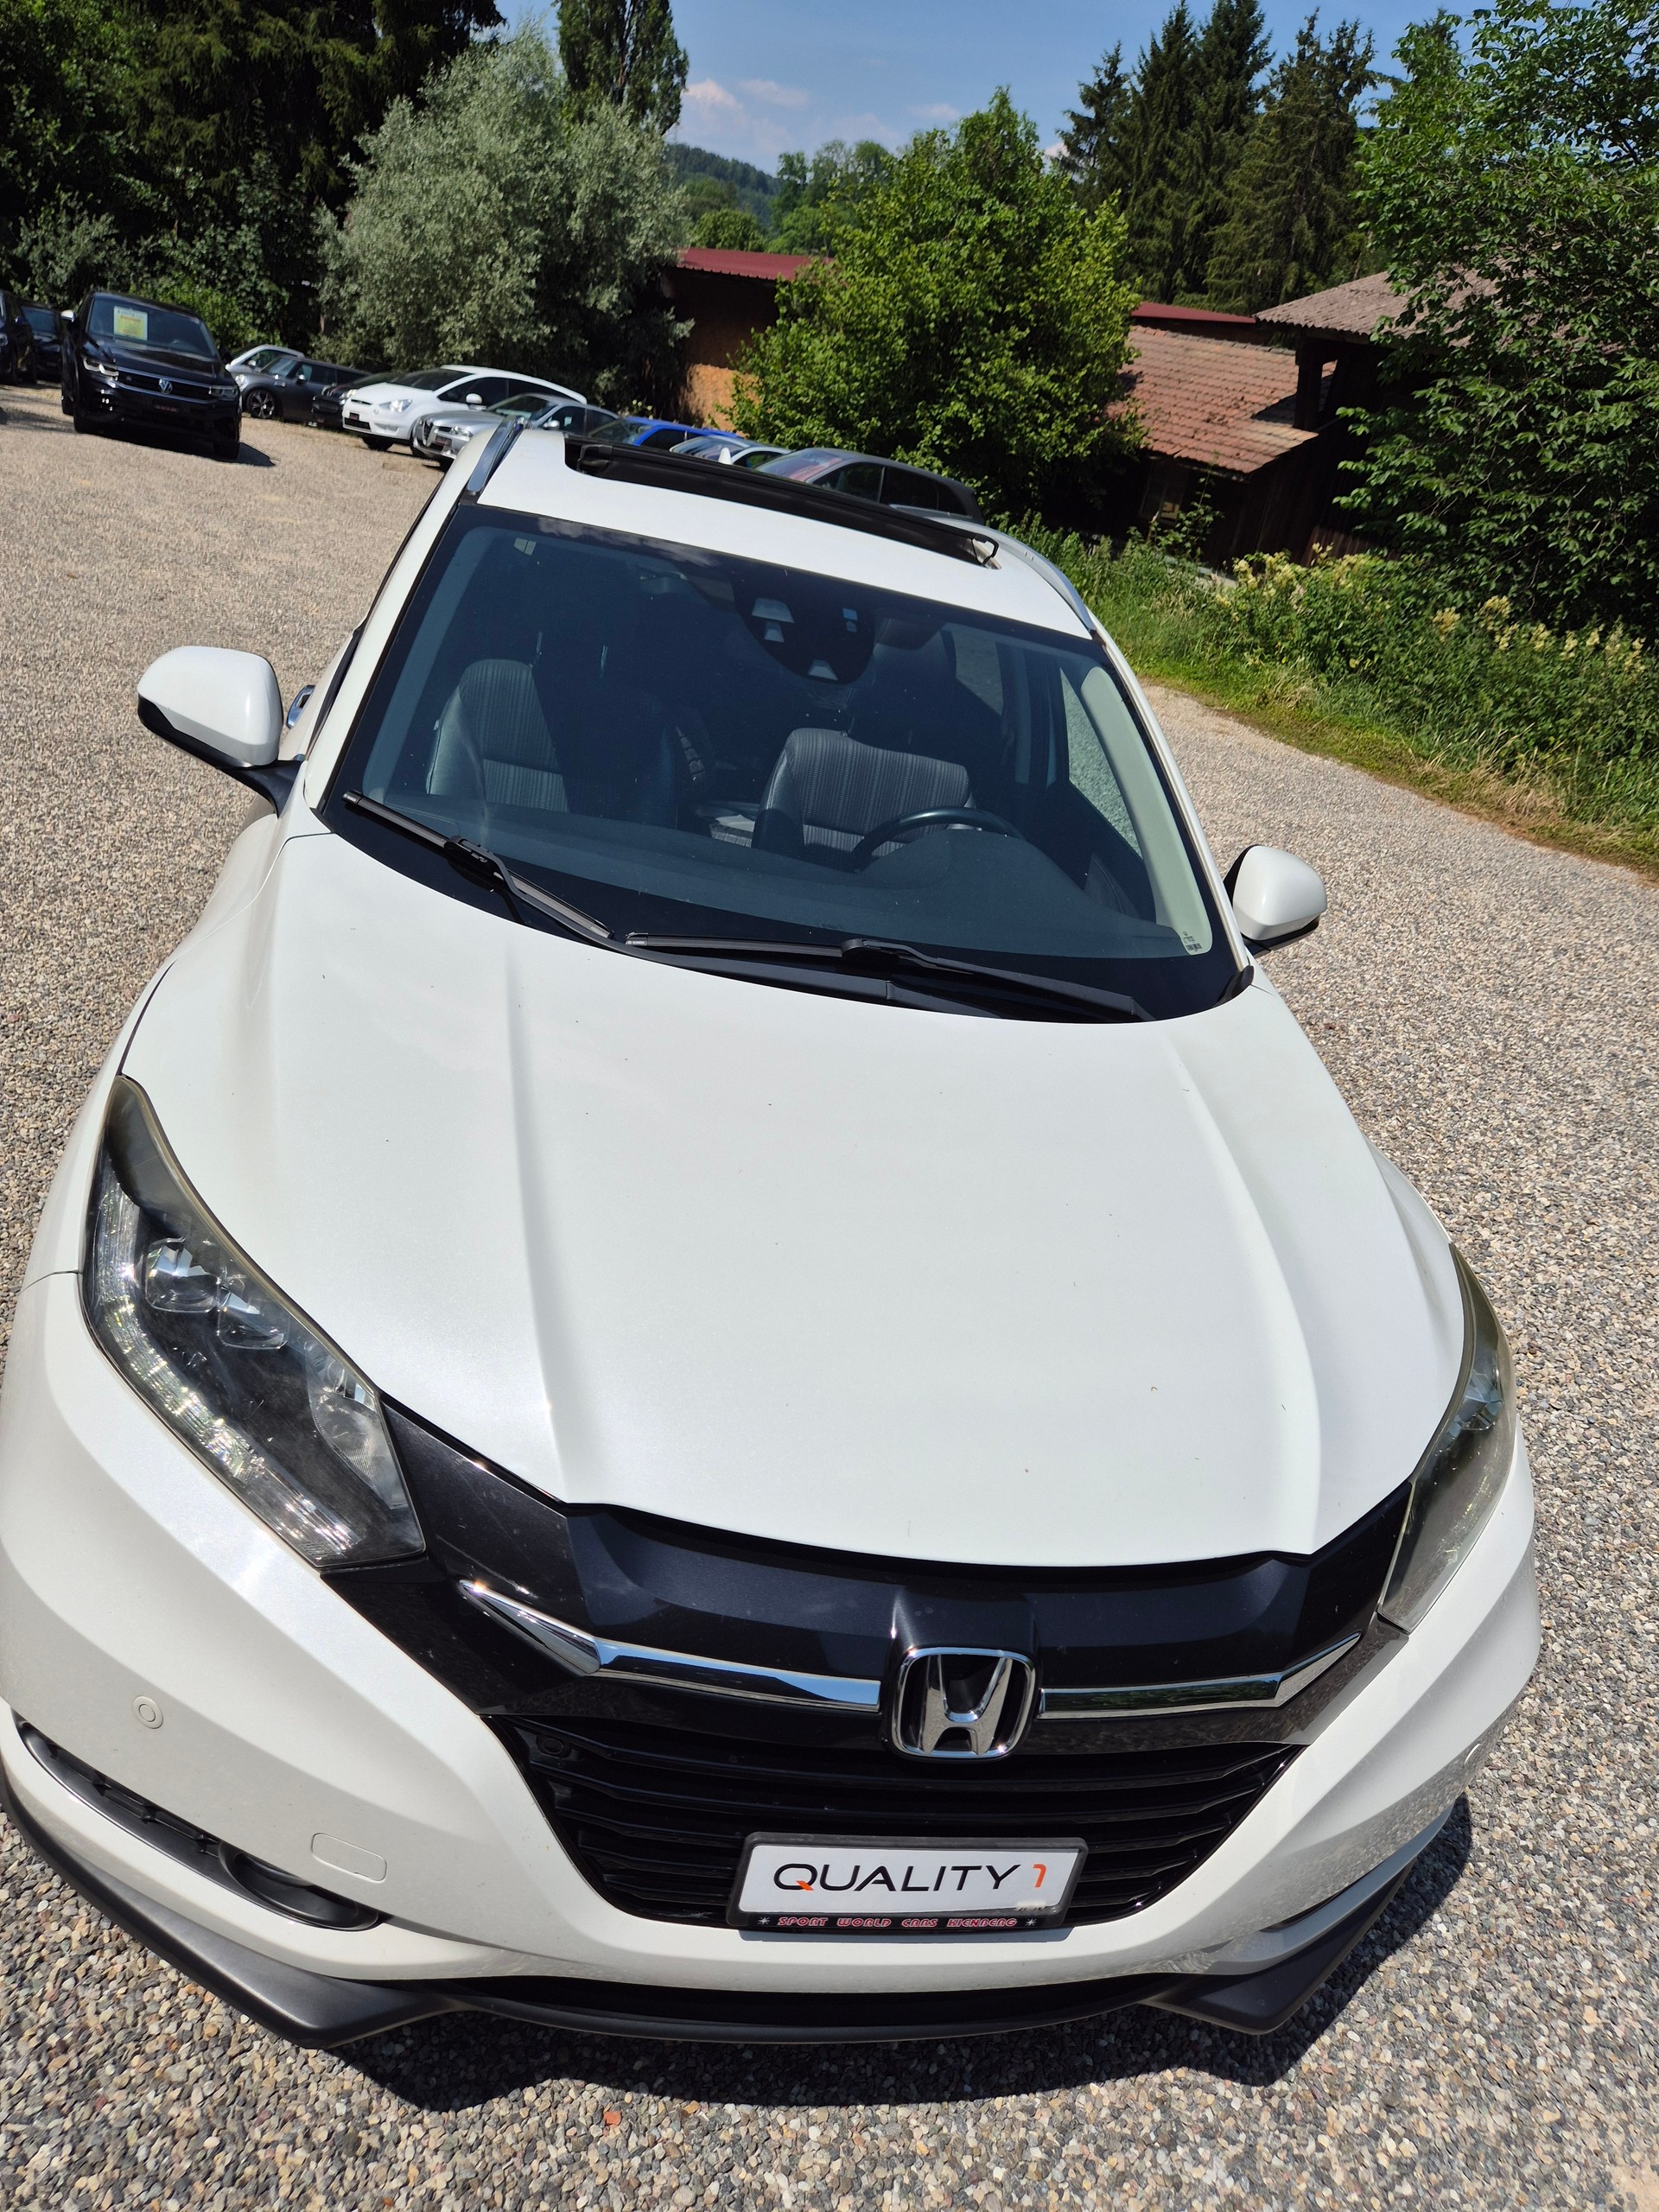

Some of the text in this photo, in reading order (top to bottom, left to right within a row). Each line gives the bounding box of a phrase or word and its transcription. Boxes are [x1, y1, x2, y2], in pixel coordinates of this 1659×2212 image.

[773, 1863, 1047, 1891] QUALITY 1
[778, 1916, 1018, 1928] SPORT WORLD CARS KIENBERG
